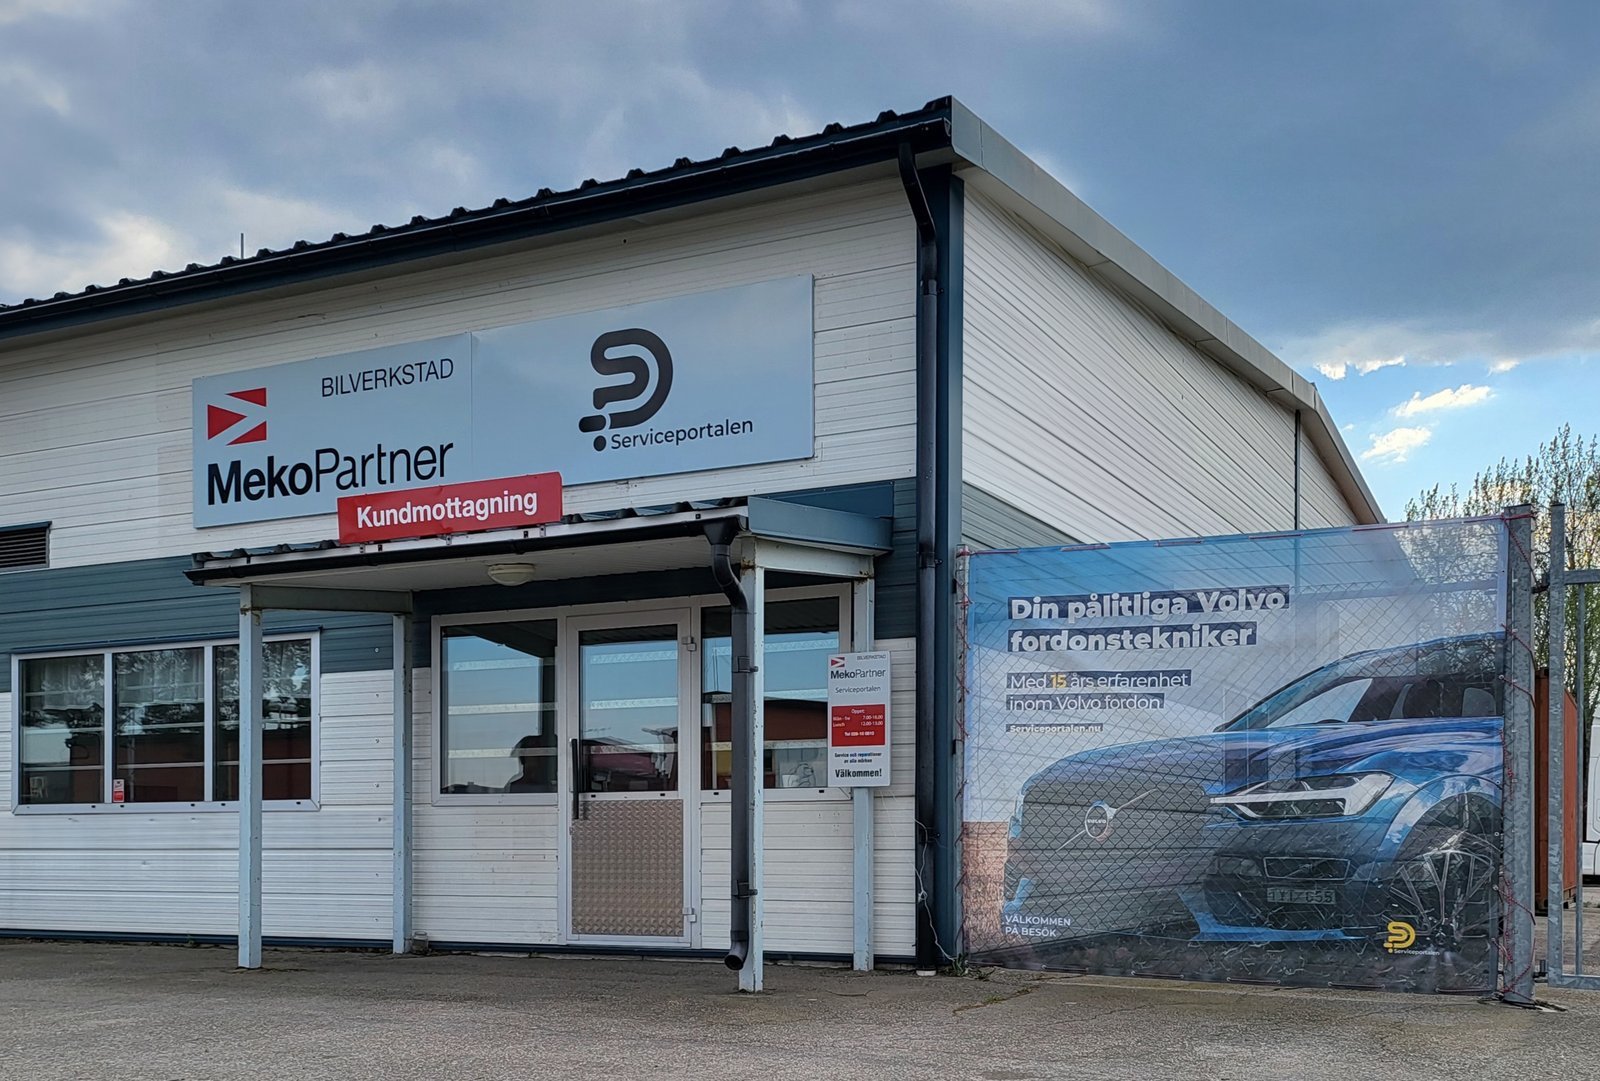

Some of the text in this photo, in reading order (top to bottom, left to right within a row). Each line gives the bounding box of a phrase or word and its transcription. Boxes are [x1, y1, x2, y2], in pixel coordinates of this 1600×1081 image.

[321, 358, 454, 397] BILVERKSTAD
[611, 418, 753, 450] Serviceportalen
[207, 442, 454, 506] MekoPartner
[356, 490, 538, 529] Kundmottagning
[1011, 589, 1286, 624] Din pålitliga Volvo
[1010, 624, 1253, 652] fordonstekniker
[830, 669, 886, 679] MekoPartner
[1010, 671, 1189, 690] Med 15 års erfarenhet
[835, 686, 881, 694] Serviceportalen
[1009, 694, 1161, 711] inom Volvo fordon
[1009, 724, 1102, 733] Serviceportalen.nu
[834, 768, 882, 778] Välkommen!
[1005, 914, 1071, 926] VÄLKOMMEN
[1005, 924, 1057, 937] PÅ BESÖK
